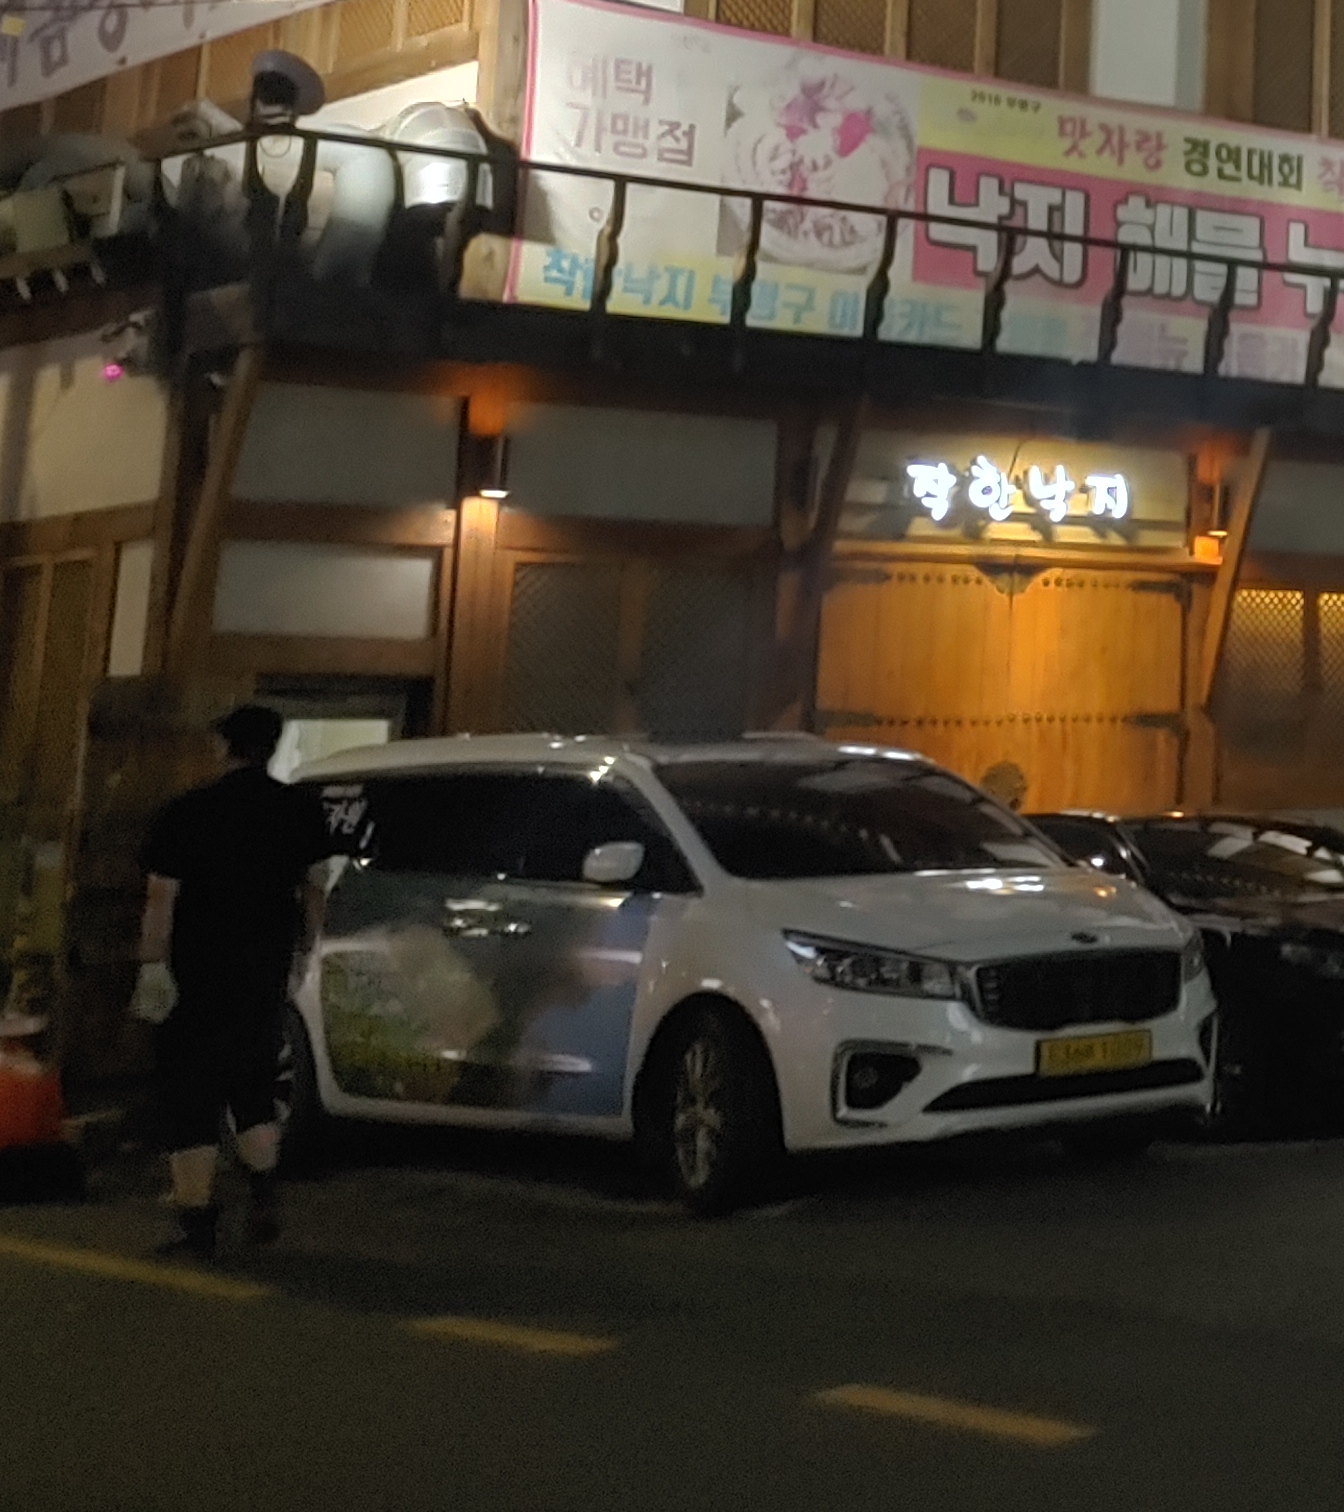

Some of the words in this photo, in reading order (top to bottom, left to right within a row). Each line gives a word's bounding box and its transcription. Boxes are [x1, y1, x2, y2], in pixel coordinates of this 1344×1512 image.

[566, 100, 699, 169] 가맹점
[1056, 113, 1168, 172] 맛자랑
[1181, 134, 1306, 194] 경연대회
[925, 165, 1089, 288] 낙지
[1116, 194, 1265, 312] 해물
[906, 455, 1131, 522] 착한낙지
